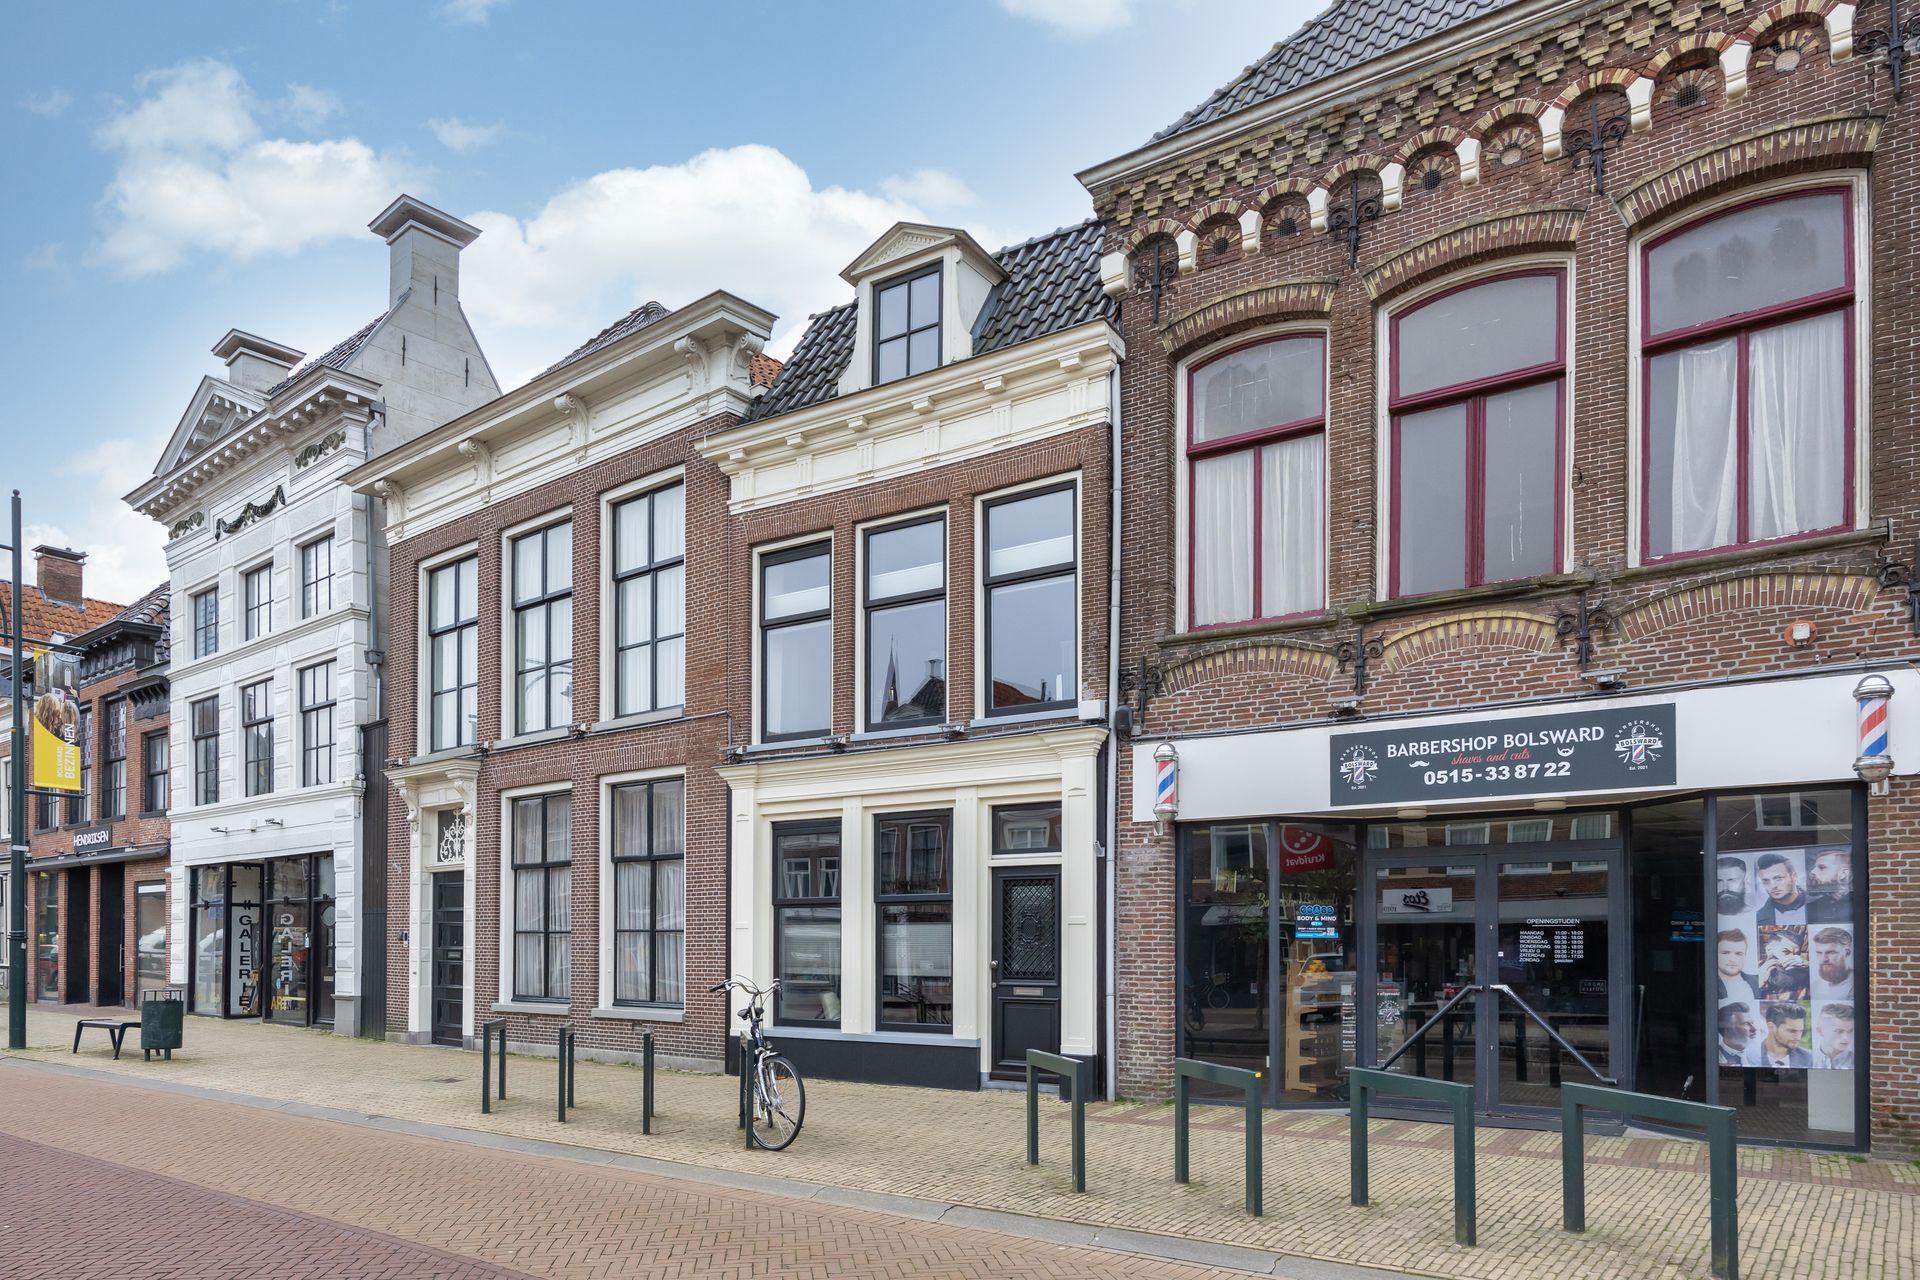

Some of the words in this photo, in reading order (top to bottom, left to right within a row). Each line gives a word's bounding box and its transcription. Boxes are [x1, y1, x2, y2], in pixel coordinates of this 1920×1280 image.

[1614, 720, 1663, 738] BARBERSHOP
[64, 723, 75, 779] BEZINNEN
[1387, 736, 1498, 758] BARBERSHOP
[1504, 726, 1604, 749] BOLSWARD
[1620, 738, 1657, 746] BOLSWARD
[1451, 753, 1482, 765] shaves
[1486, 749, 1508, 762] and
[1510, 748, 1531, 760] cuts
[239, 915, 252, 1006] GALERIE
